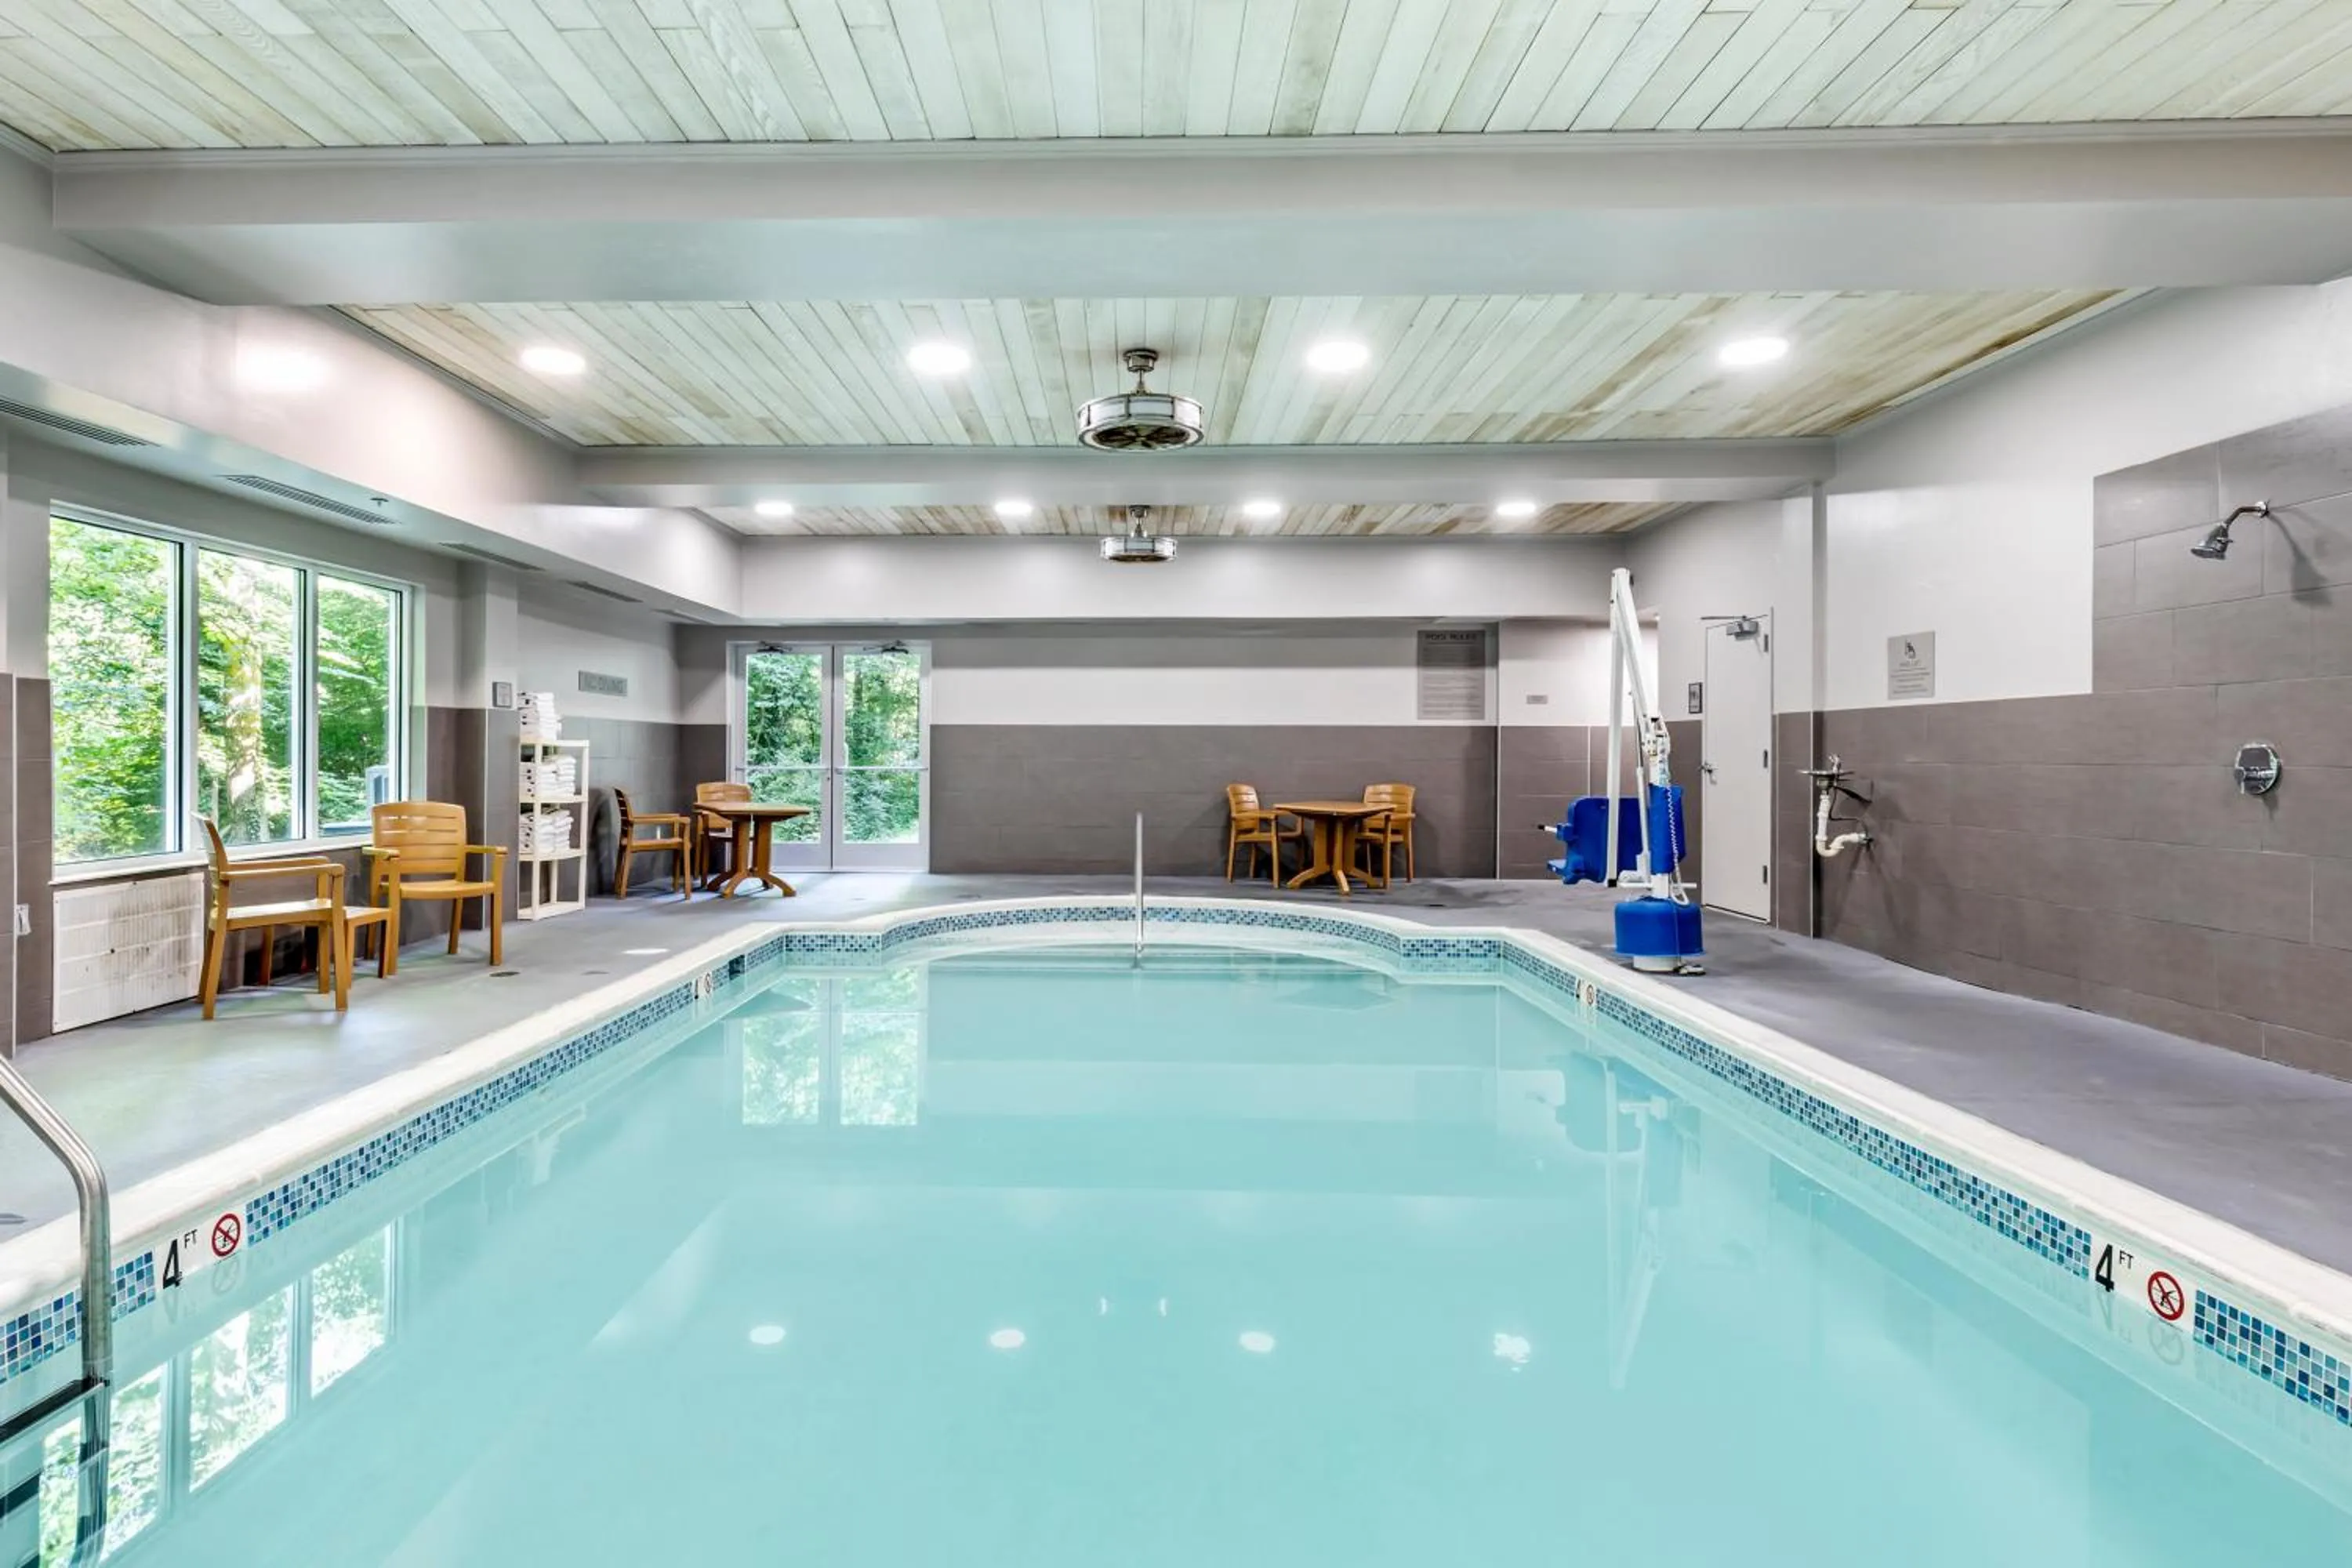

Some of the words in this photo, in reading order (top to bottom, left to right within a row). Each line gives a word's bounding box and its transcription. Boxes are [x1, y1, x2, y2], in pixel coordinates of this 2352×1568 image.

[163, 1239, 182, 1289] 4
[183, 1229, 198, 1248] FT
[2095, 1243, 2114, 1293] 4
[2119, 1250, 2134, 1269] FT
